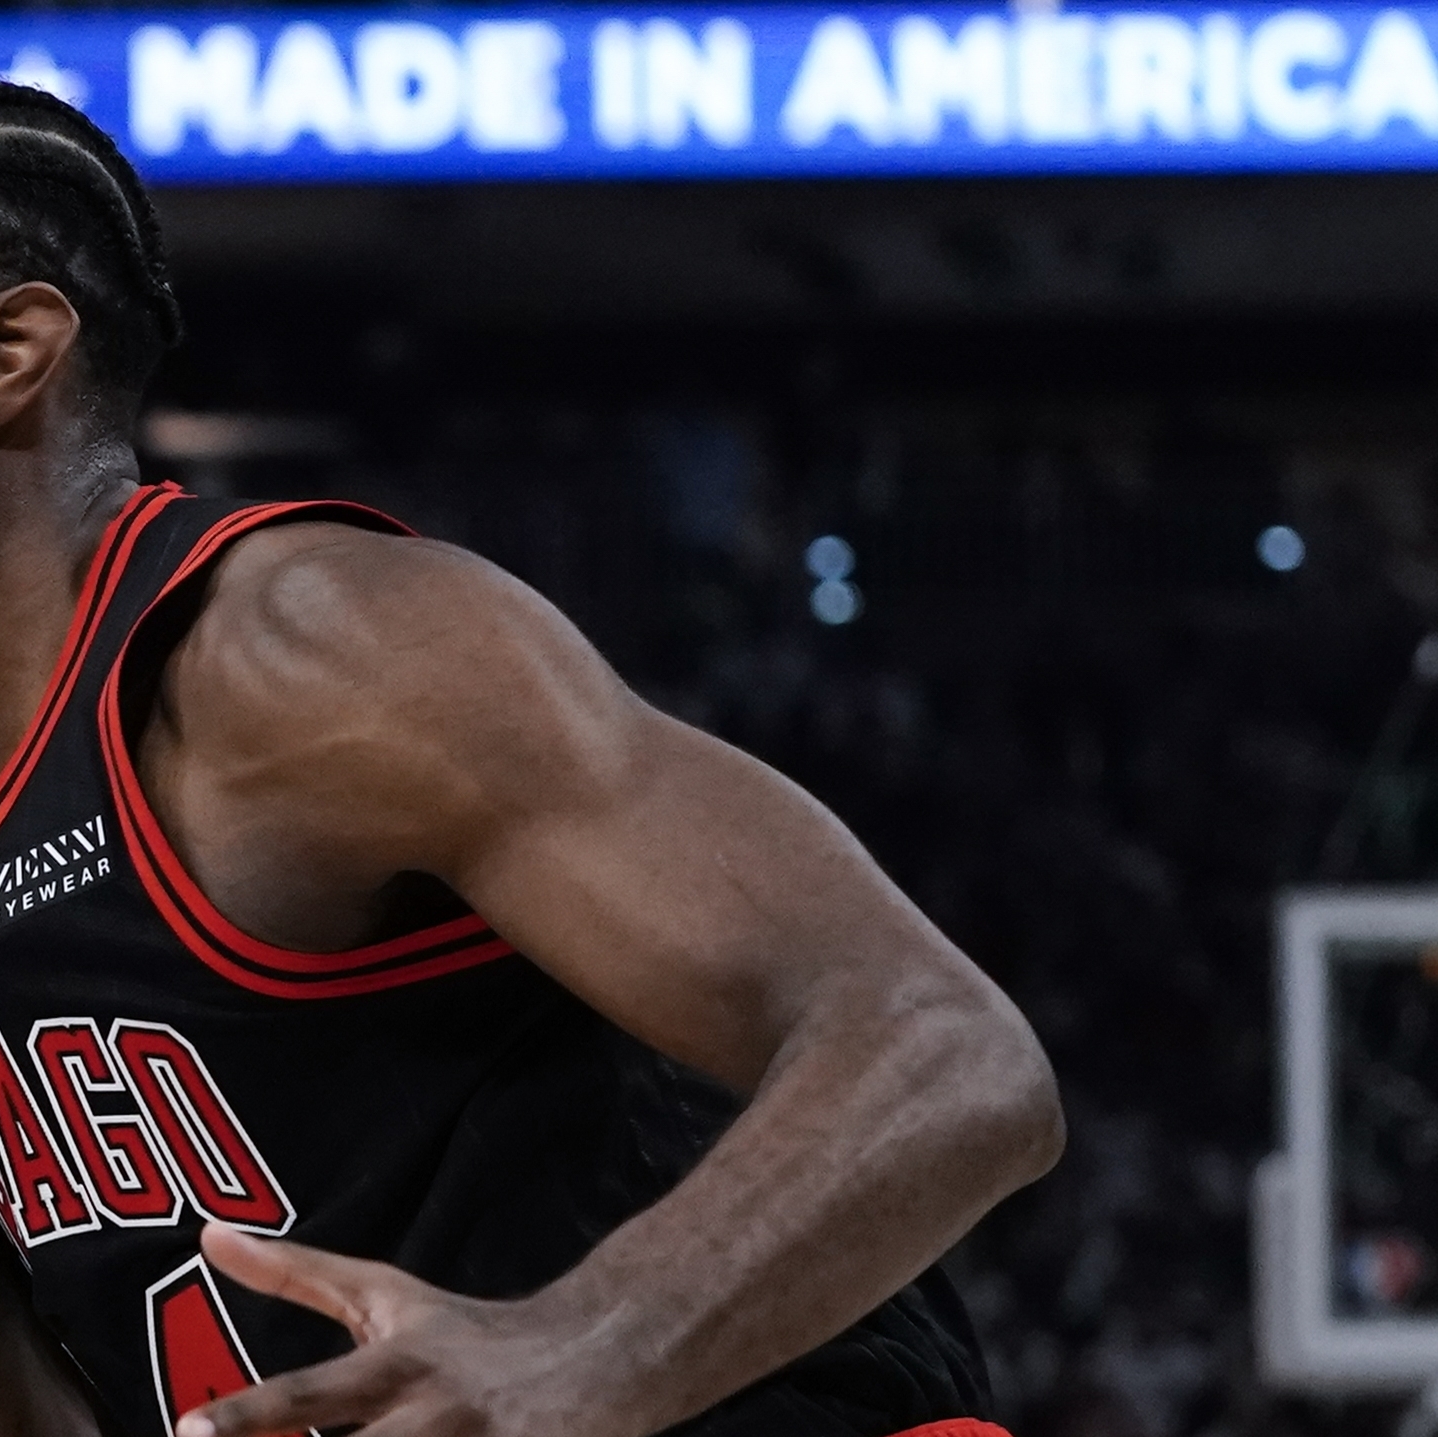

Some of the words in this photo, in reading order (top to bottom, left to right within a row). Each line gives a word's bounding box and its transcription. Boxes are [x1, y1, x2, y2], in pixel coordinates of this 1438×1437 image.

[128, 21, 565, 155] MADE
[591, 17, 754, 149] IN
[780, 9, 1438, 148] AMERICA
